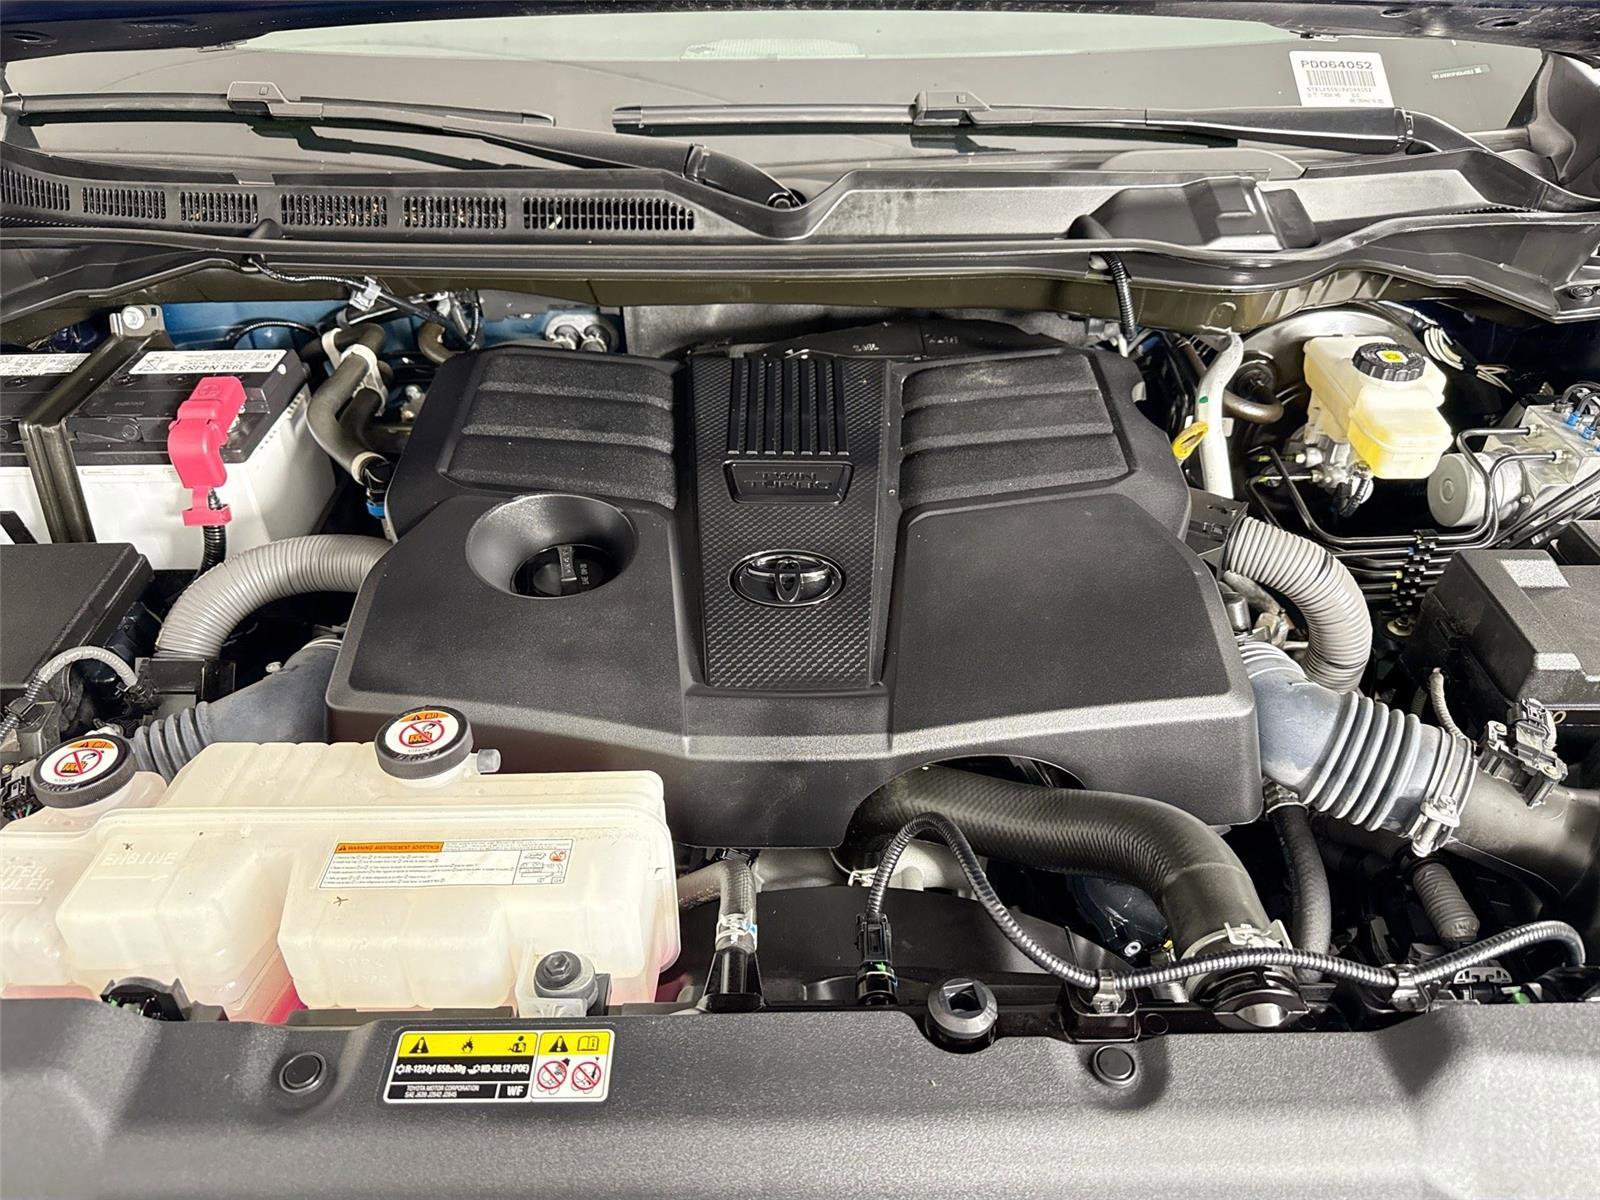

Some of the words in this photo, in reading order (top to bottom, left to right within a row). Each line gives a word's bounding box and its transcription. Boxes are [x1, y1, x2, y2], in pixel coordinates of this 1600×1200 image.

[1300, 60, 1373, 69] PD064052
[755, 471, 817, 480] TWIN
[743, 480, 833, 489] TURBO
[101, 851, 179, 866] ENGINE
[511, 1064, 530, 1074] (POE)
[507, 1085, 524, 1096] WF
